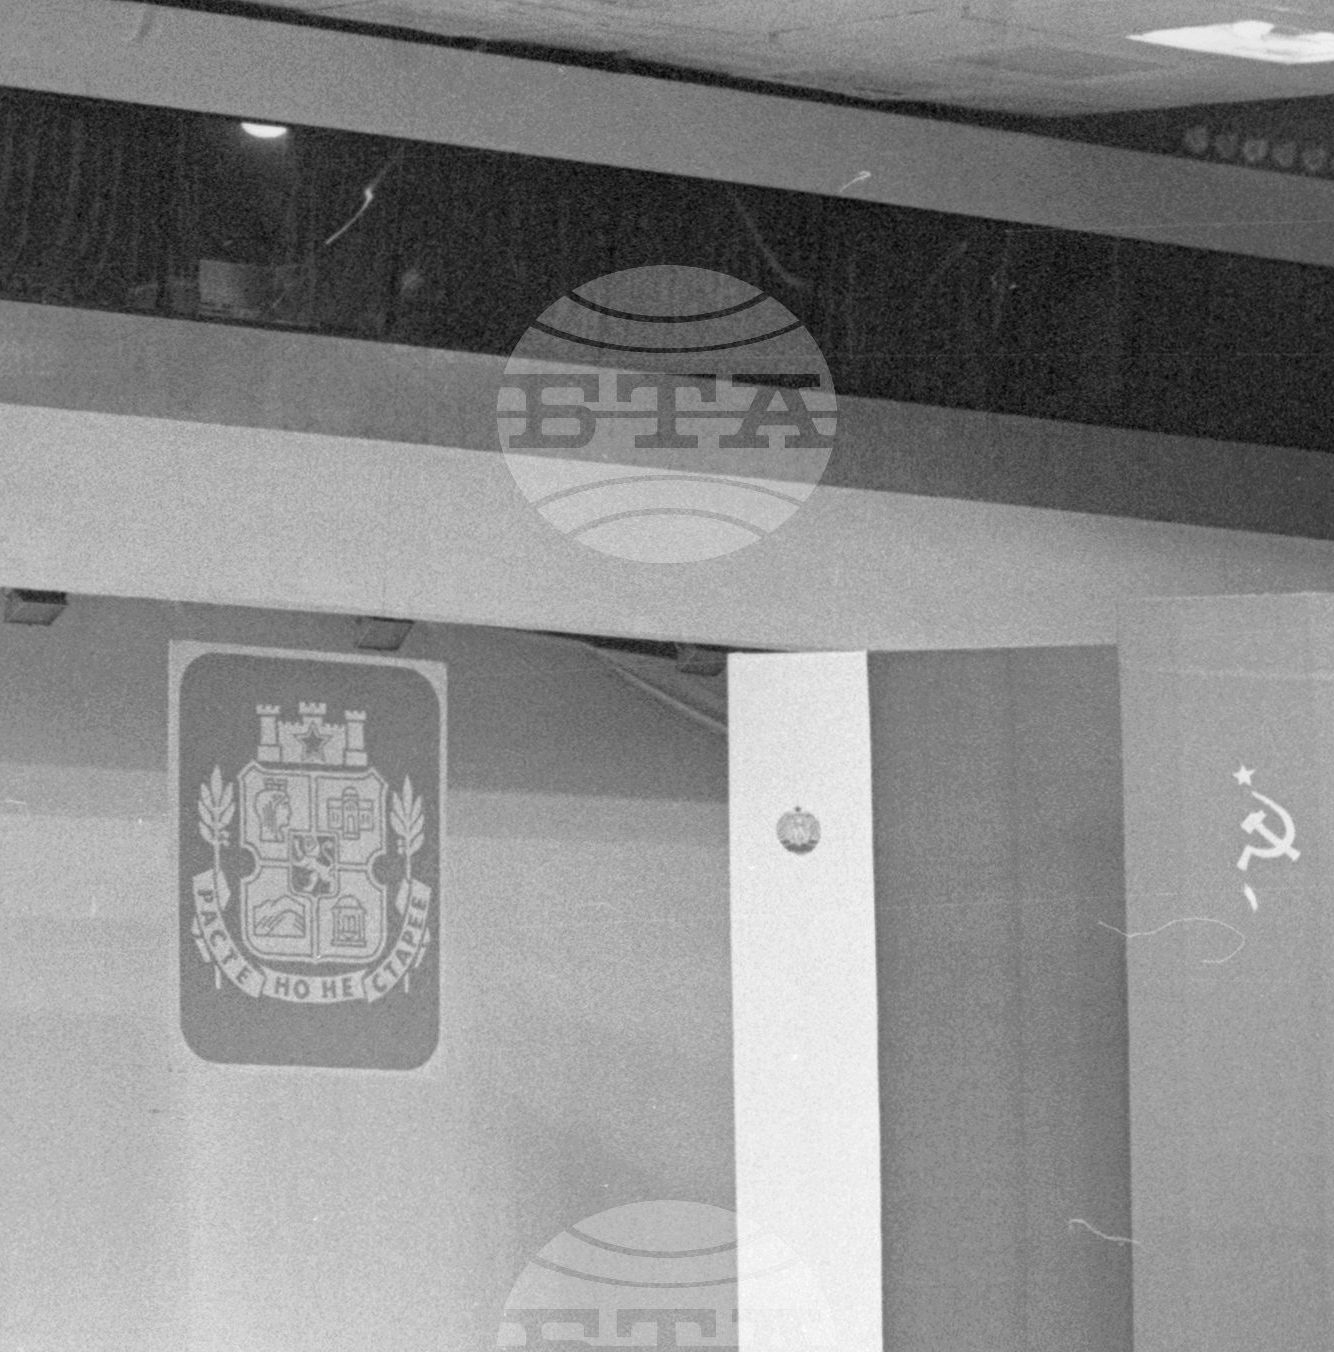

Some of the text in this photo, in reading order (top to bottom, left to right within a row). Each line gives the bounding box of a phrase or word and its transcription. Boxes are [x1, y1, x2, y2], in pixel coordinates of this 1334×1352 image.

[197, 889, 428, 999] РАСТЕ НО НЕ СТАРЕЕ
